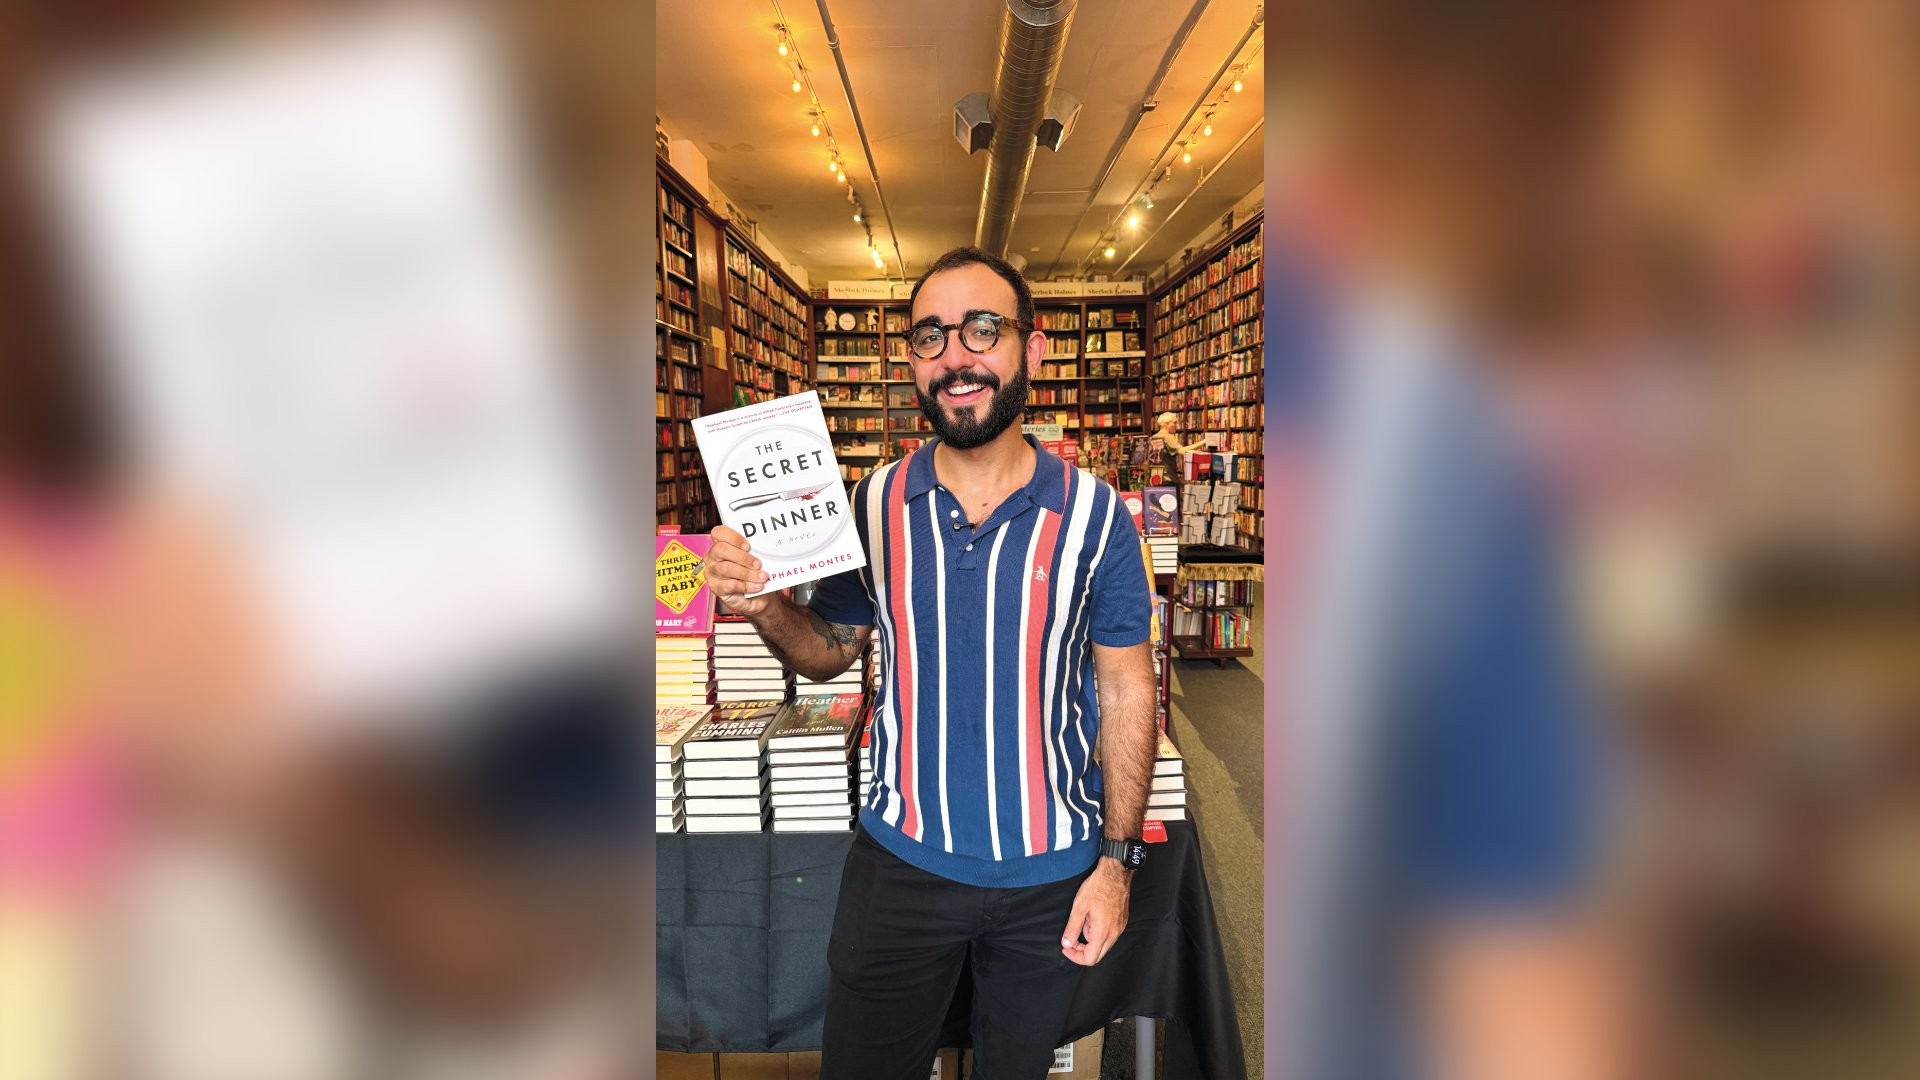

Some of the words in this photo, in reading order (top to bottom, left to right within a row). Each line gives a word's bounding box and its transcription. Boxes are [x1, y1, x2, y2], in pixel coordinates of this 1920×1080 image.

[755, 440, 782, 455] THE
[727, 449, 822, 488] SECRET
[741, 500, 839, 538] DINNER
[660, 554, 692, 566] THREE
[767, 566, 804, 582] PHAEL
[809, 553, 852, 570] MONTES
[667, 574, 683, 583] AND
[660, 578, 697, 594] BABY
[720, 700, 778, 709] ICARUS
[795, 696, 859, 706] Heather
[729, 709, 760, 720] 17
[699, 721, 767, 731] CHARLES
[776, 727, 808, 735] Caitlin
[691, 727, 763, 738] CUMMING
